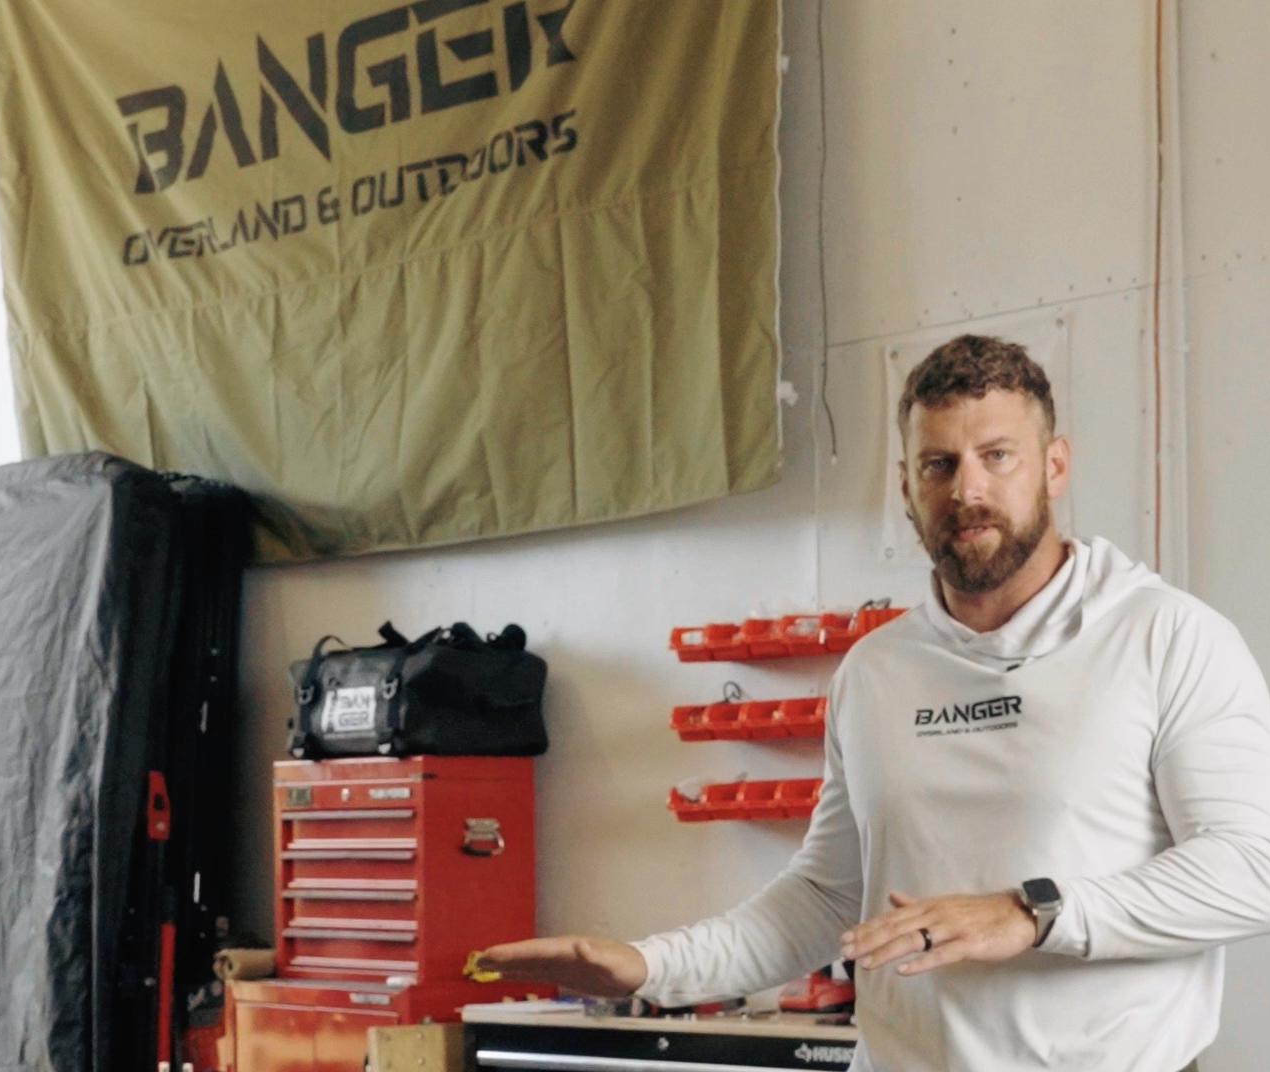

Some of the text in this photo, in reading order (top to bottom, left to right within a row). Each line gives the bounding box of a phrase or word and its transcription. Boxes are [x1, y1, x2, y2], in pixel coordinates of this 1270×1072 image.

[317, 186, 341, 225] &
[915, 696, 1022, 725] BANGER
[812, 1046, 855, 1063] HUSK
